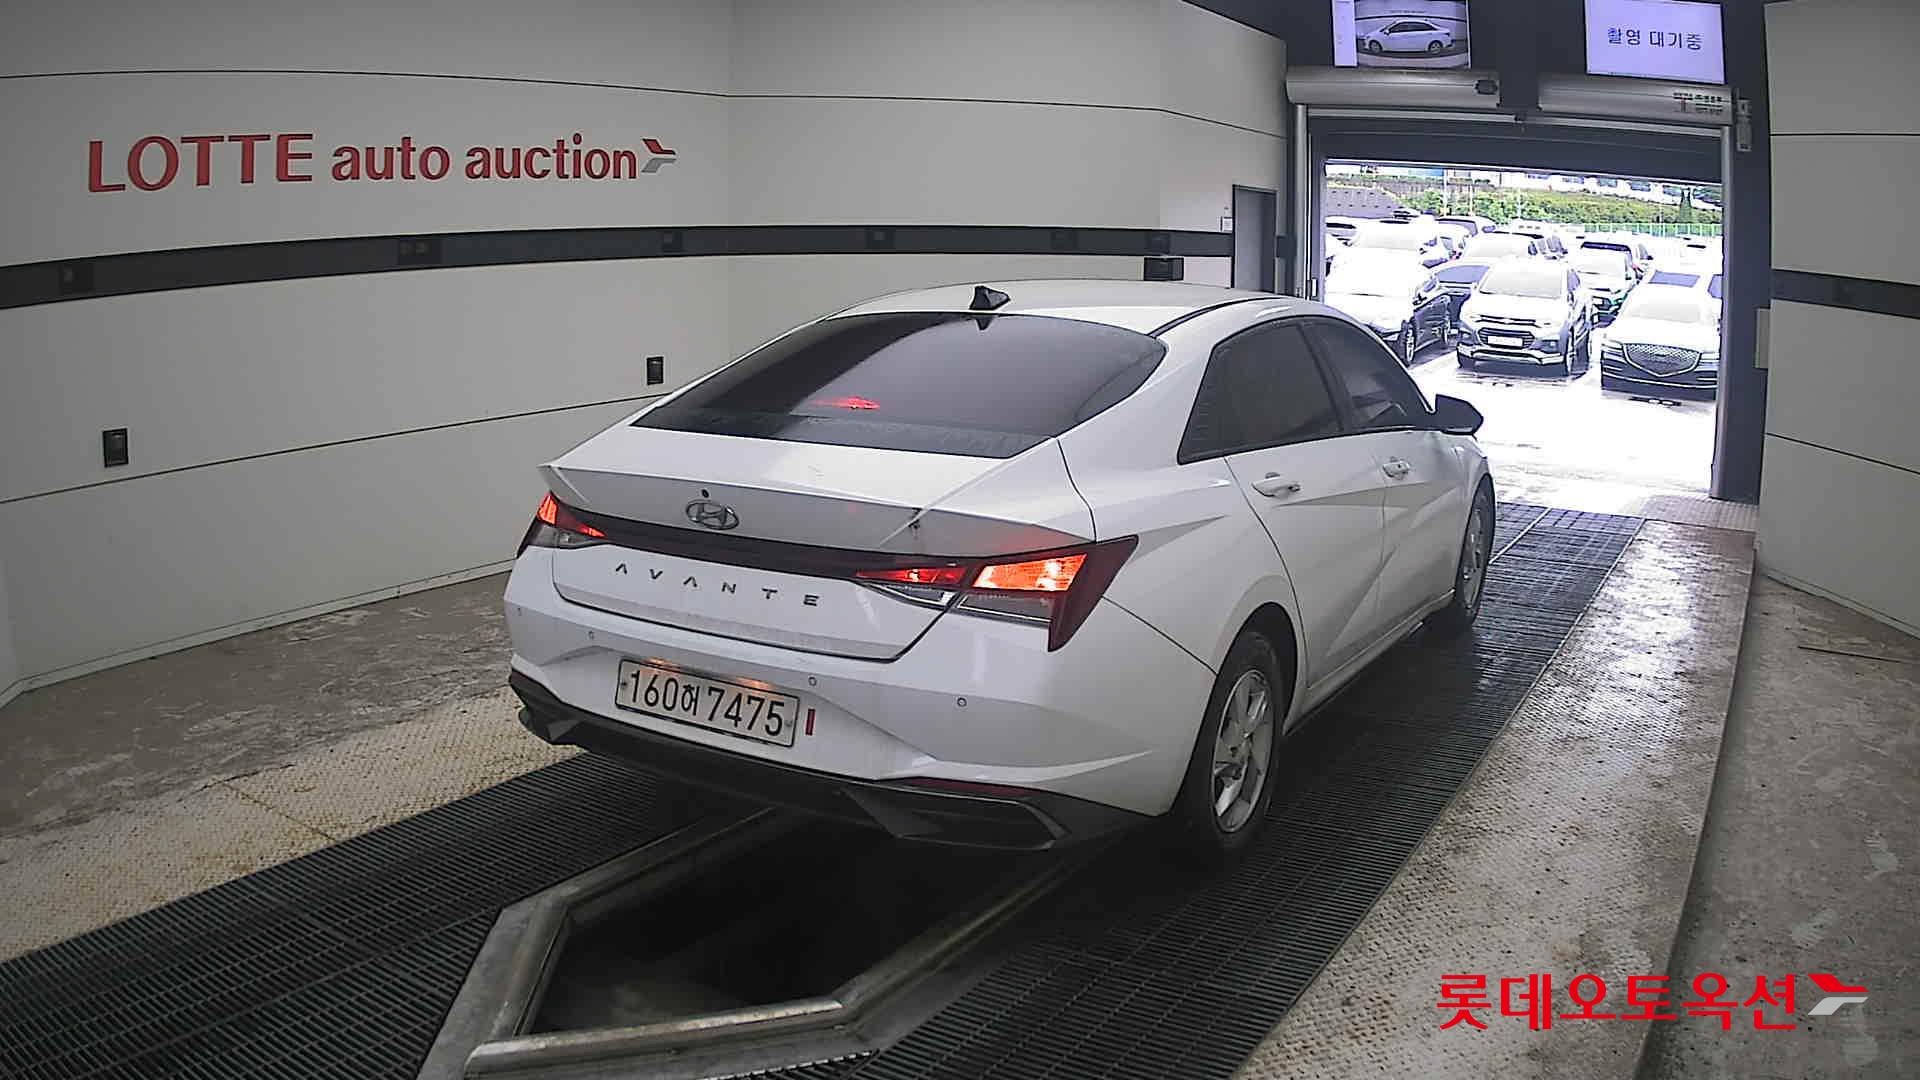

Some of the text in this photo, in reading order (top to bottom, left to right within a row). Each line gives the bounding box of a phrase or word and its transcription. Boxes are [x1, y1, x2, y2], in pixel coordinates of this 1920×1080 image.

[1607, 27, 1703, 51] 촬영 대기중
[88, 132, 638, 193] LOTTE auto auction
[615, 562, 820, 607] AVANTE
